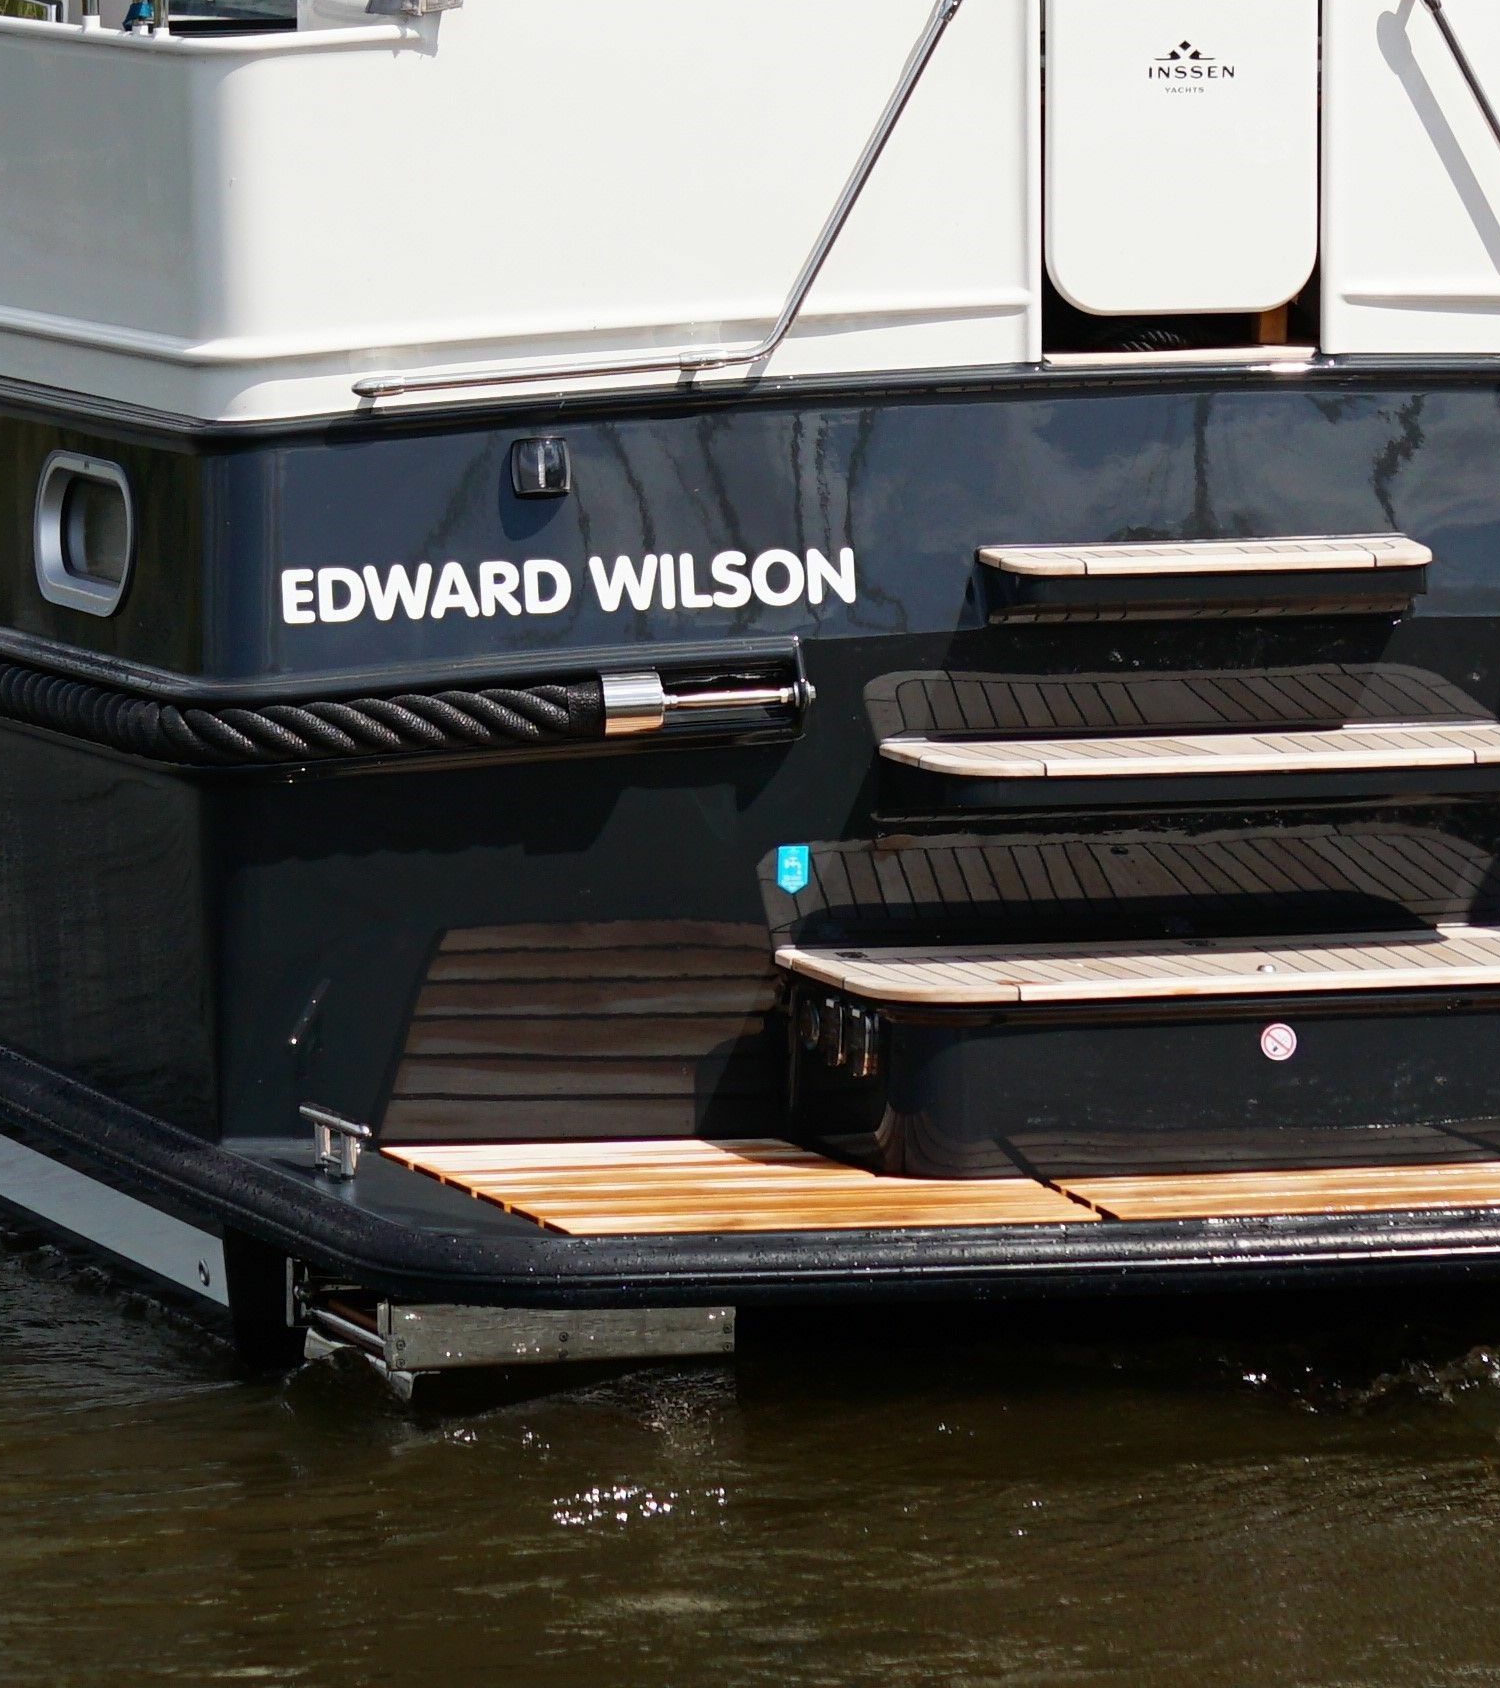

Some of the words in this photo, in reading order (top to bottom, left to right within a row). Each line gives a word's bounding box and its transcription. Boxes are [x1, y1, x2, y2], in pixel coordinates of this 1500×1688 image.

[1148, 65, 1235, 80] INSSEN
[1164, 86, 1205, 94] YACHTS
[281, 559, 572, 624] EDWARD
[589, 548, 857, 612] WILSON
